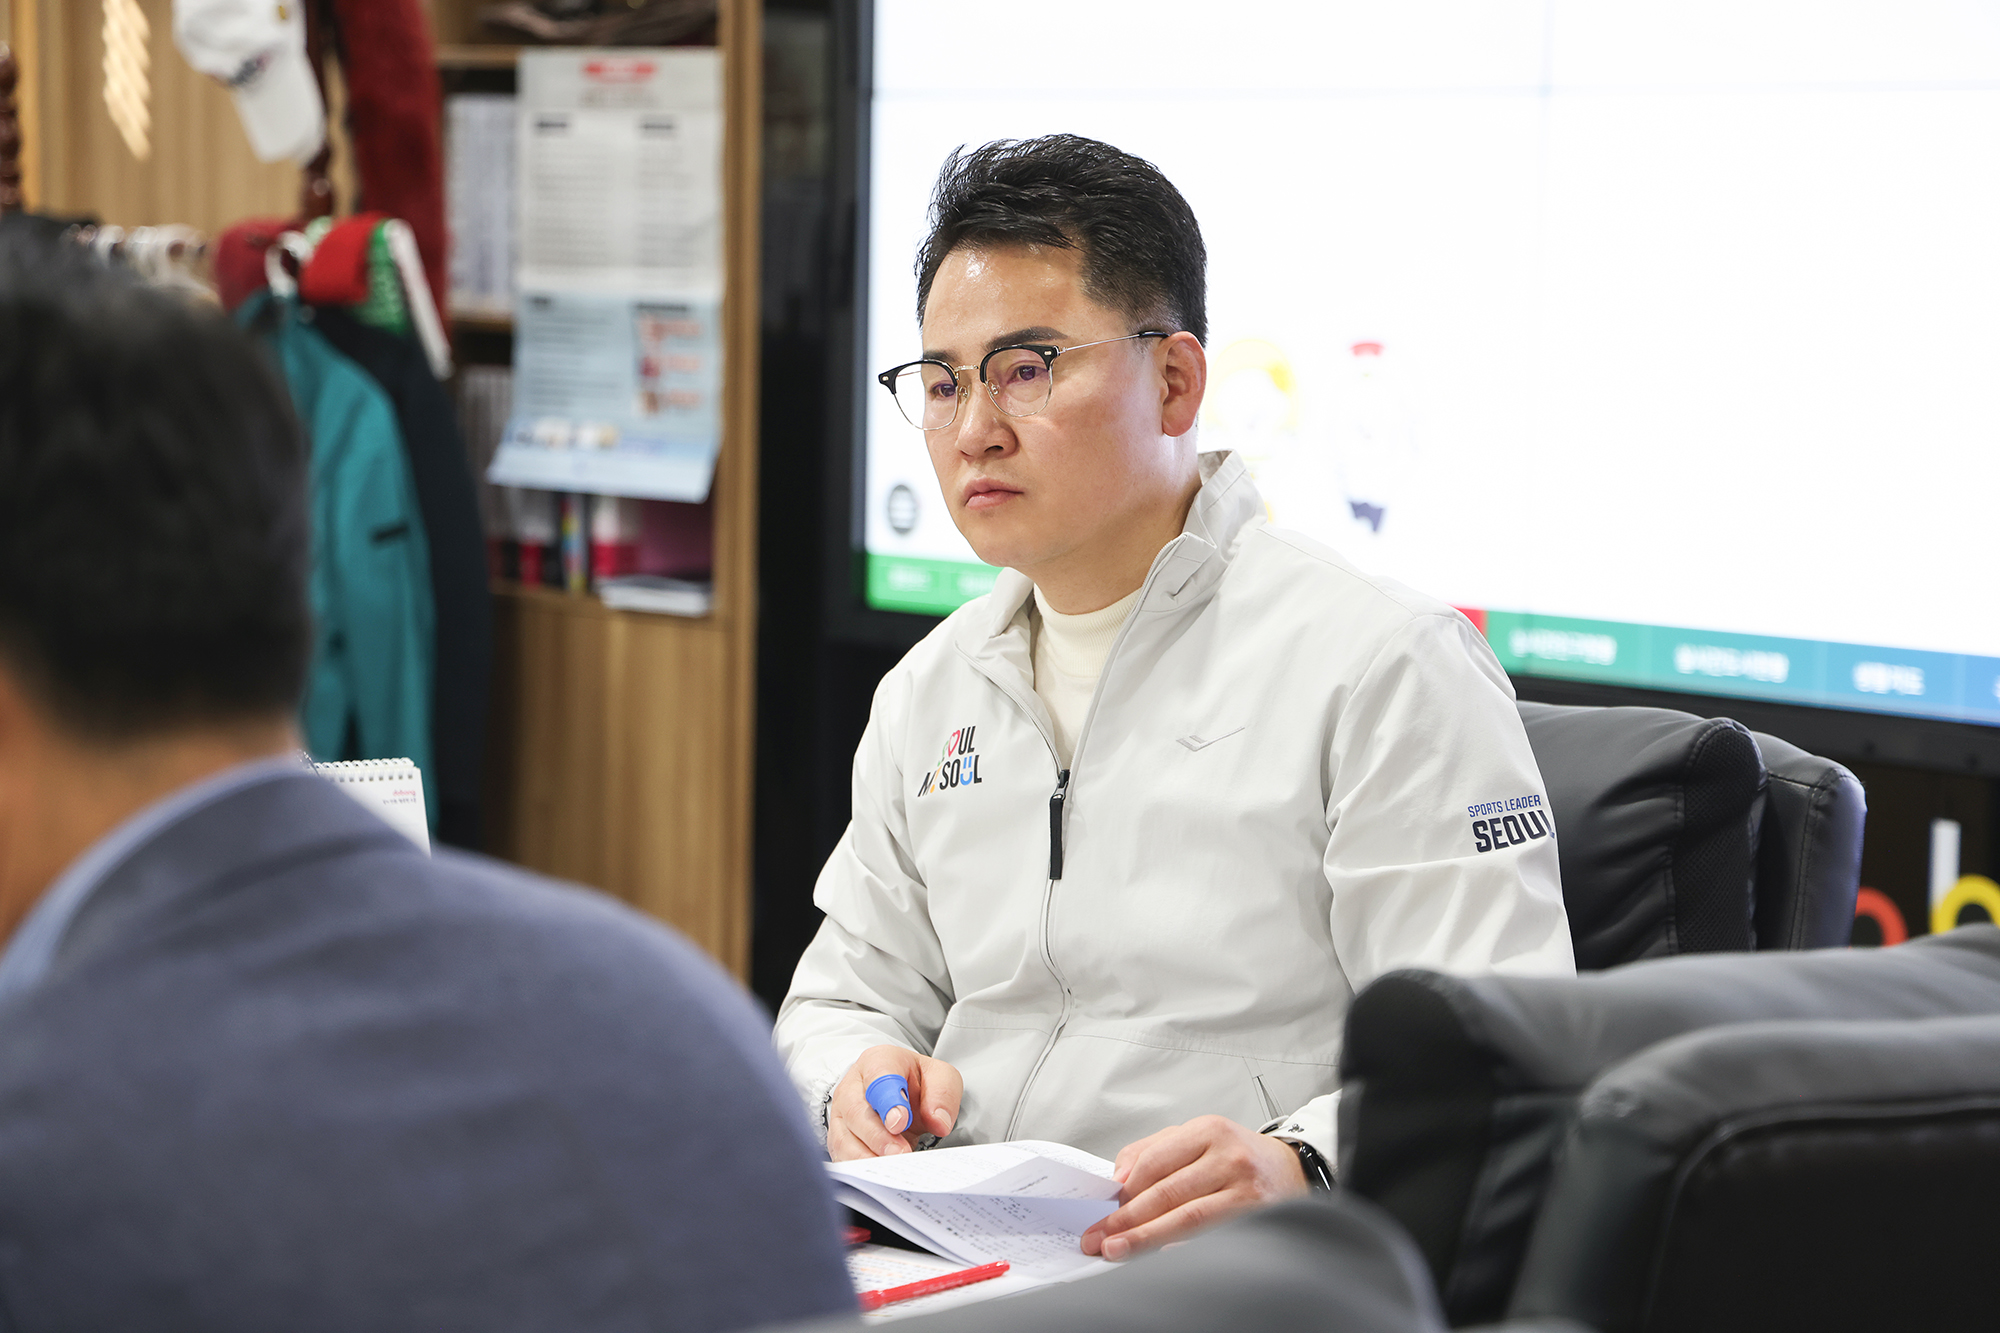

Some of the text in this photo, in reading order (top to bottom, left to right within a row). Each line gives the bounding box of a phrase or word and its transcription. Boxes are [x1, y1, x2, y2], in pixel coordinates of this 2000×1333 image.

[939, 754, 982, 790] SOUL
[1467, 794, 1542, 817] SPORTS LEADER
